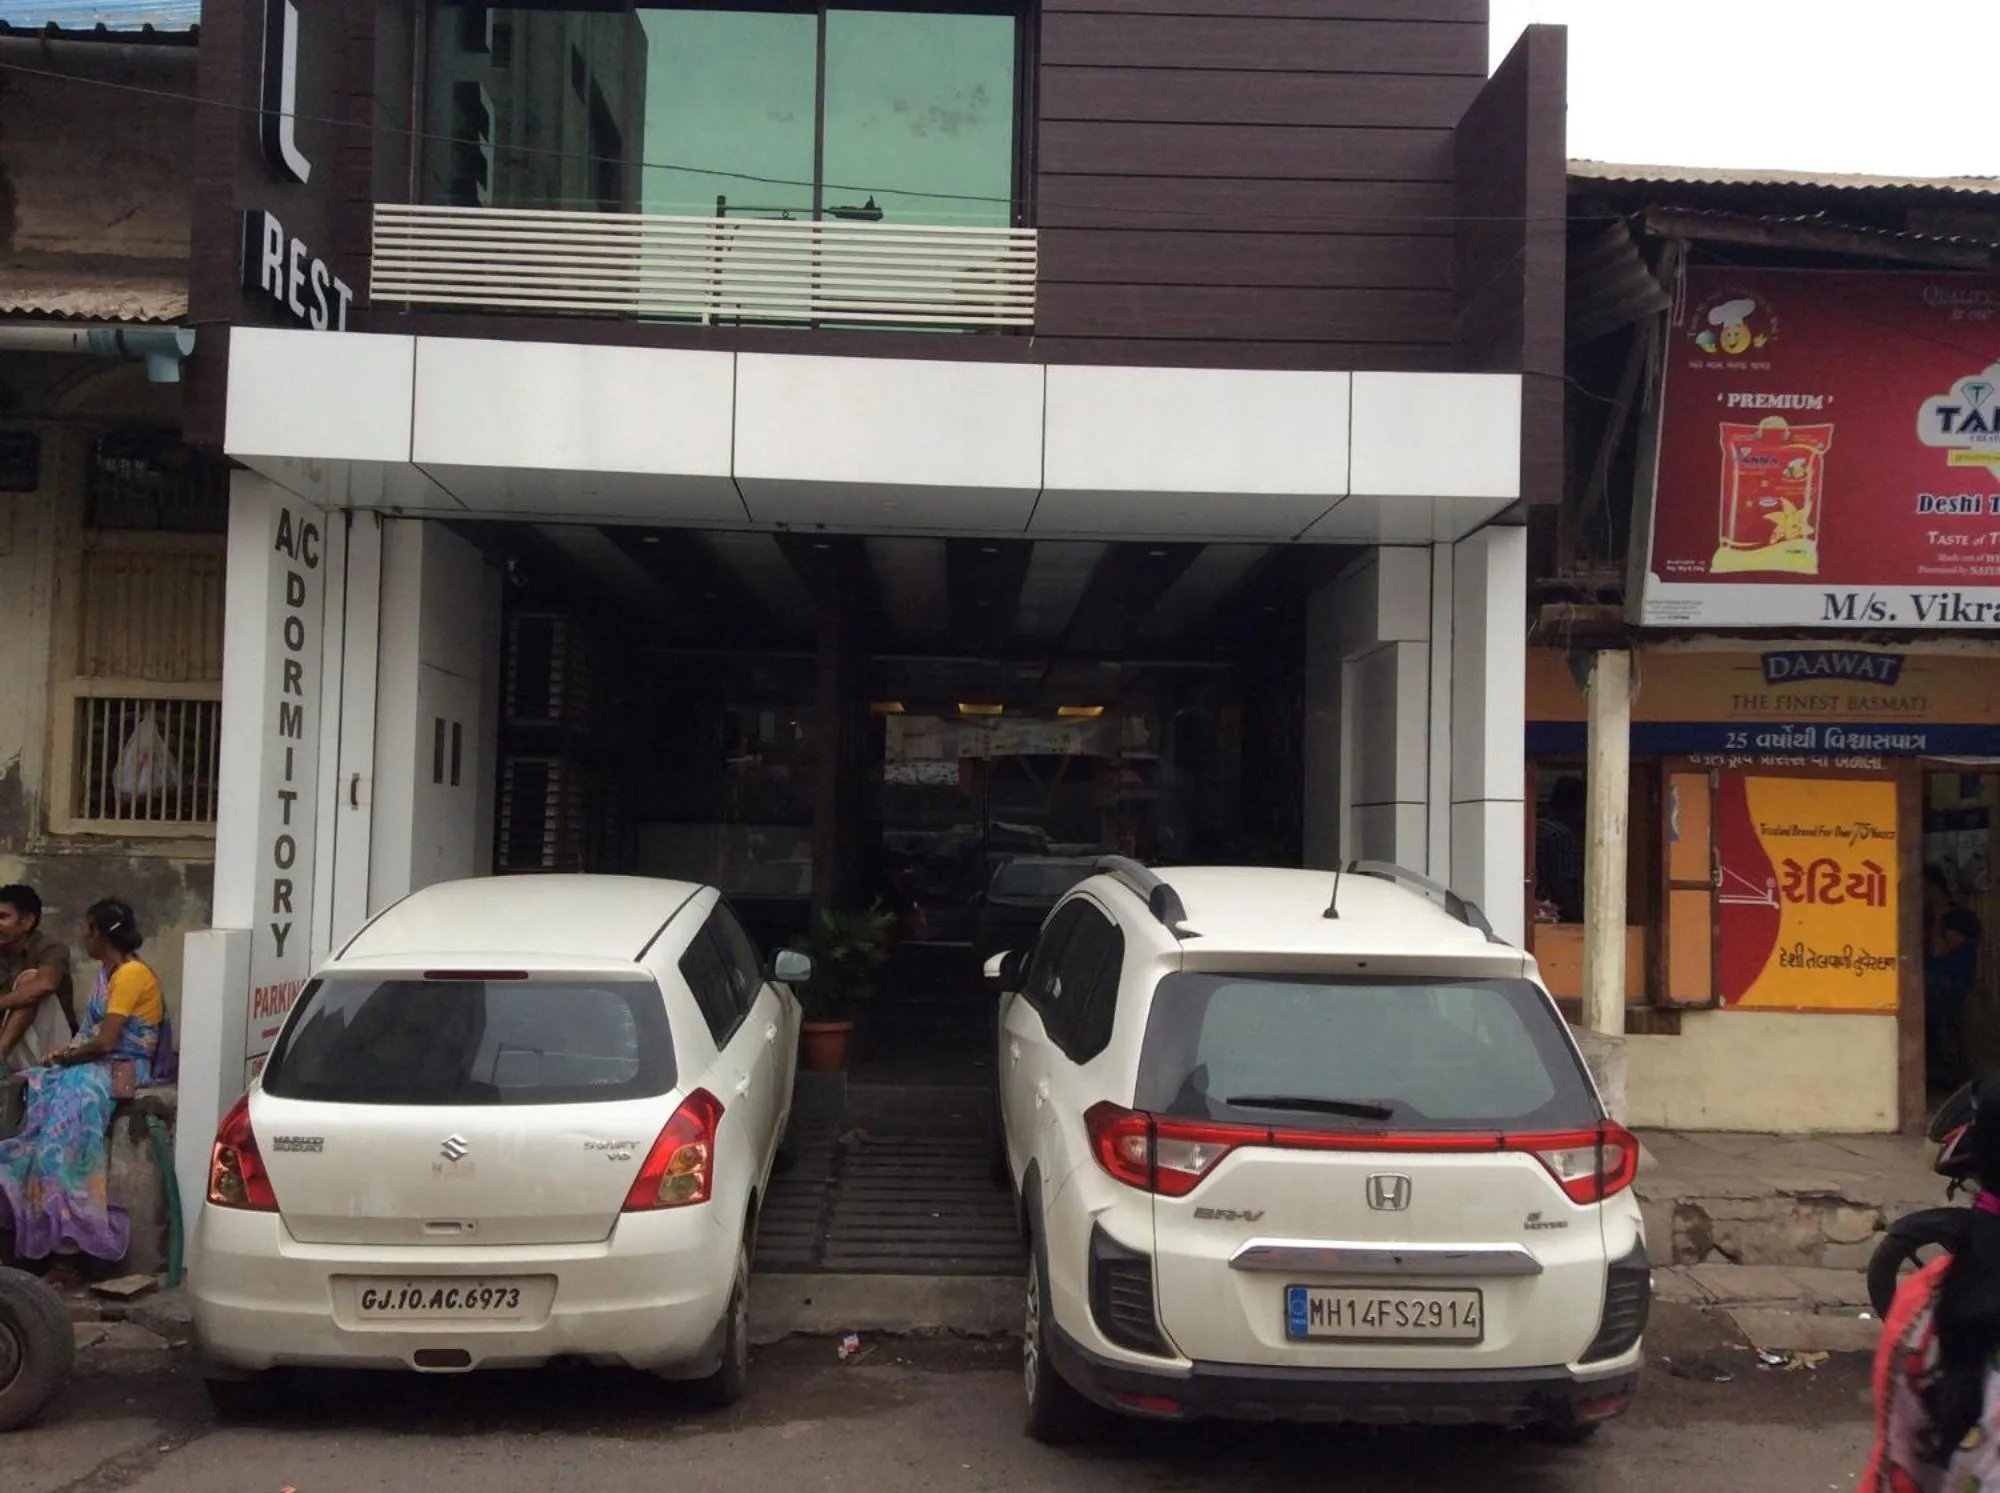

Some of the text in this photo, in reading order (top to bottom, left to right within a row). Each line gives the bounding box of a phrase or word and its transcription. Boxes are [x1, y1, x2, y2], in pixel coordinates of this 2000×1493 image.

[261, 209, 353, 332] REST
[275, 508, 320, 570] A/C
[1820, 592, 1898, 622] M/s.
[1768, 652, 1898, 679] DAAWAT
[1731, 694, 1928, 712] THE FINEST BASMATI
[1724, 732, 1749, 749] 25
[271, 571, 306, 958] DORMITORY
[254, 977, 308, 1019] PARKIN
[361, 1287, 521, 1311] GJ.10.AC.6973
[1310, 1298, 1476, 1328] MH14FS2914
